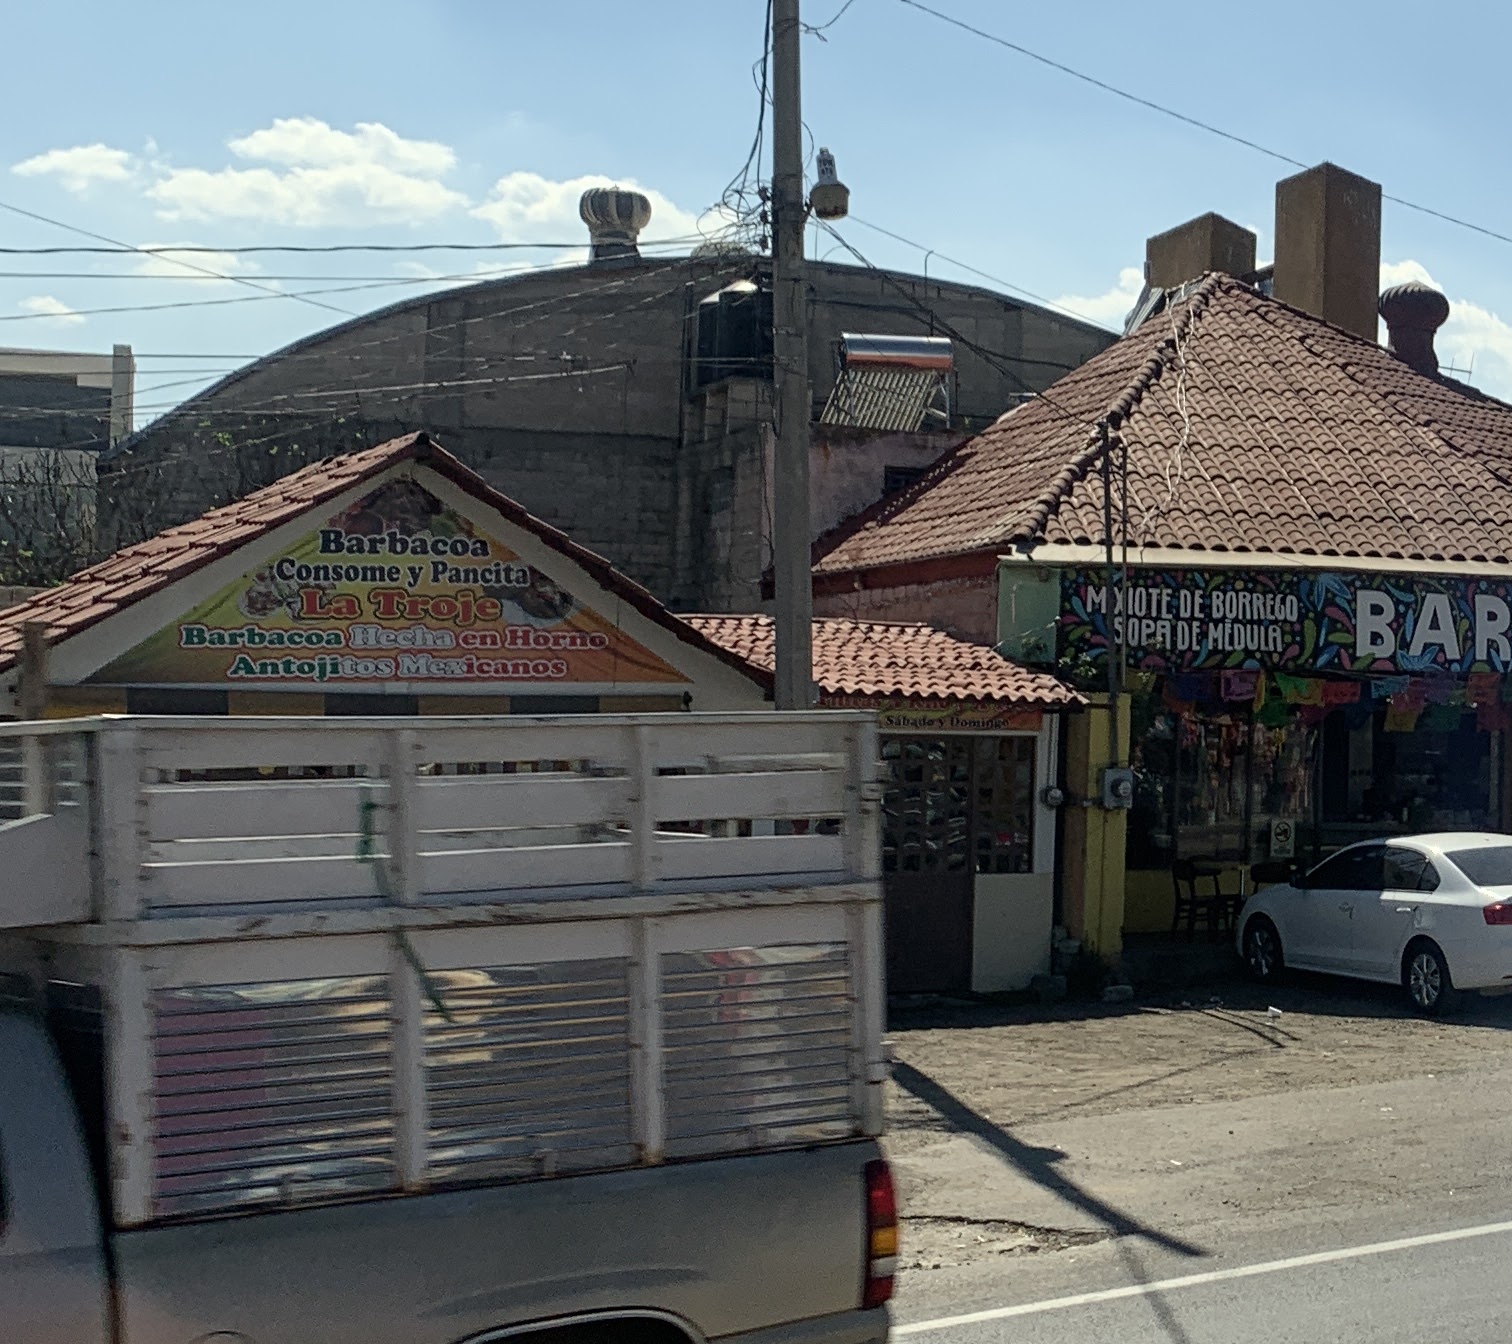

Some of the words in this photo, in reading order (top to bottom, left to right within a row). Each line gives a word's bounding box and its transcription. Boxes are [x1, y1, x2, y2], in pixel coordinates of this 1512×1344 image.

[319, 529, 489, 556] Barbacoa
[275, 557, 401, 582] Consome
[408, 564, 423, 586] y
[431, 561, 530, 584] Pancita
[300, 589, 361, 618] La
[369, 588, 502, 624] Troje
[1086, 585, 1173, 619] MXIOTE
[1179, 589, 1205, 618] DE
[1211, 590, 1299, 622] BORREGO
[182, 626, 343, 647] Barbacoa
[350, 625, 455, 649] Hecha
[460, 632, 500, 648] en
[505, 628, 608, 649] Horno
[1114, 617, 1172, 650] SOPA
[1176, 621, 1200, 650] DE
[1208, 618, 1283, 652] MÉDULA
[228, 656, 394, 681] Antojitos
[398, 655, 567, 676] Mexicanos
[938, 719, 945, 728] y
[950, 717, 1010, 730] Domingo
